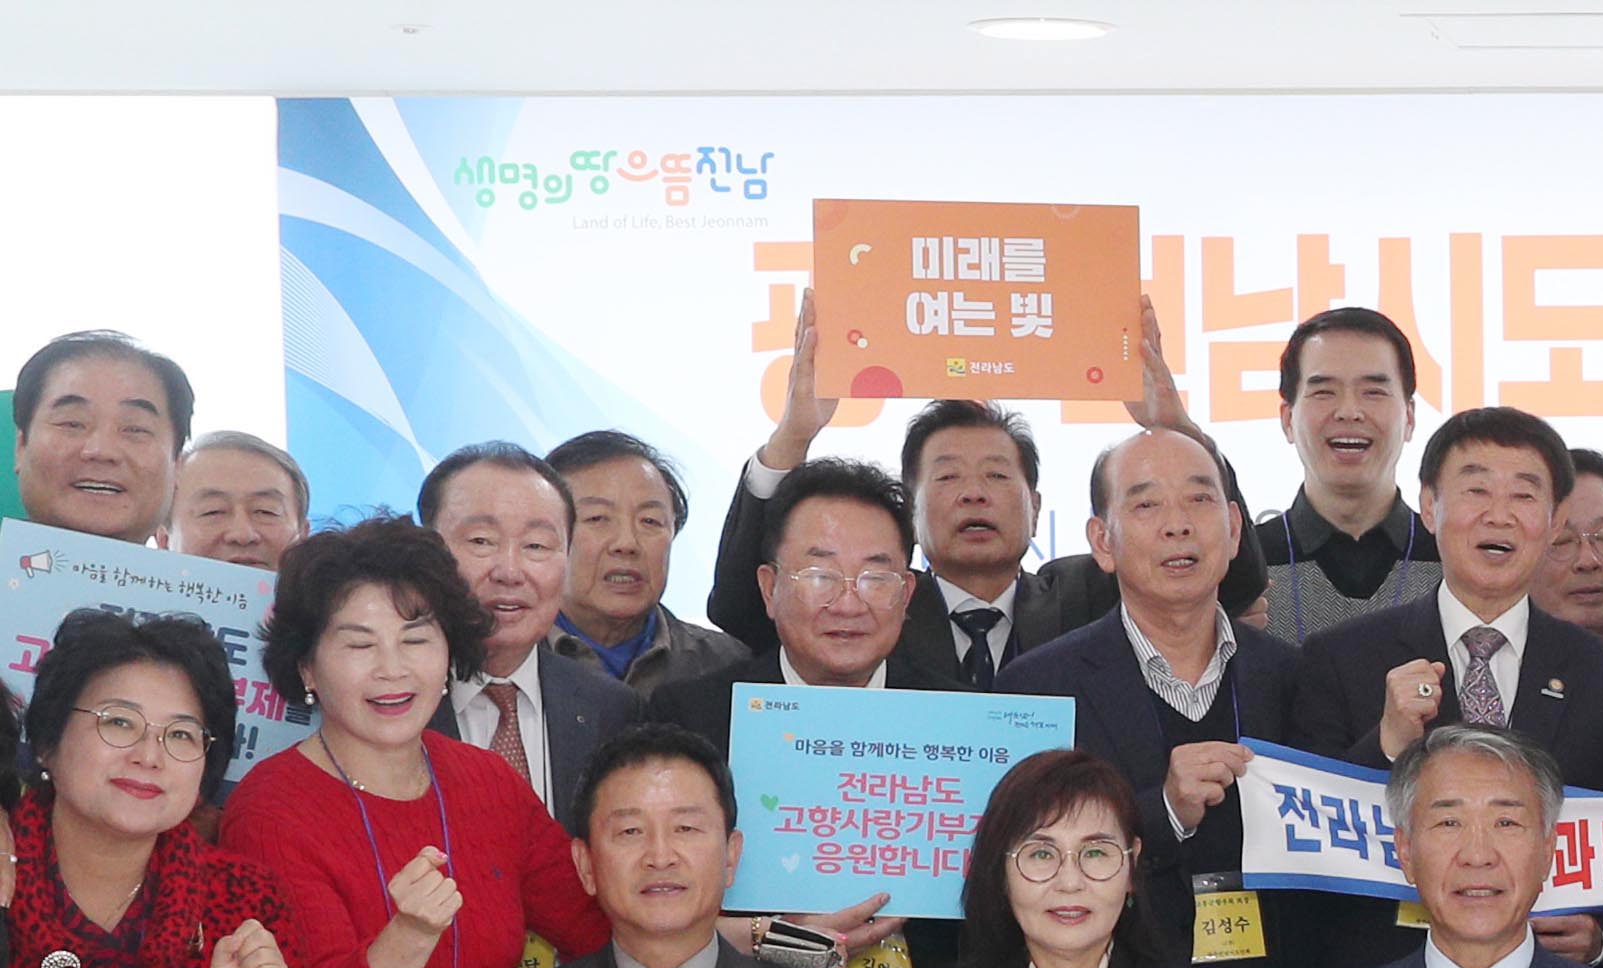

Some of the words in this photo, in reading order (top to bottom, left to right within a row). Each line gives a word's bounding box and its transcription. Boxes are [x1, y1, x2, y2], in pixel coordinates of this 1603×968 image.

[572, 215, 608, 230] Land
[613, 215, 627, 230] of
[666, 215, 696, 229] Best
[699, 215, 768, 230] Jeonnam
[911, 236, 1046, 282] 미래를
[905, 291, 995, 336] 여는
[1010, 293, 1053, 338] 빛
[969, 361, 1015, 375] 전라남도
[72, 562, 109, 583] 마음을
[113, 567, 173, 594] 함께하는
[179, 581, 223, 605] 행복한
[226, 594, 249, 610] 이음
[765, 700, 800, 711] 전라남도
[795, 739, 845, 756] 마음을
[850, 740, 918, 759] 함께하는
[923, 743, 973, 763] 행복한
[979, 746, 1010, 764] 이음
[837, 772, 965, 805] 전라남도
